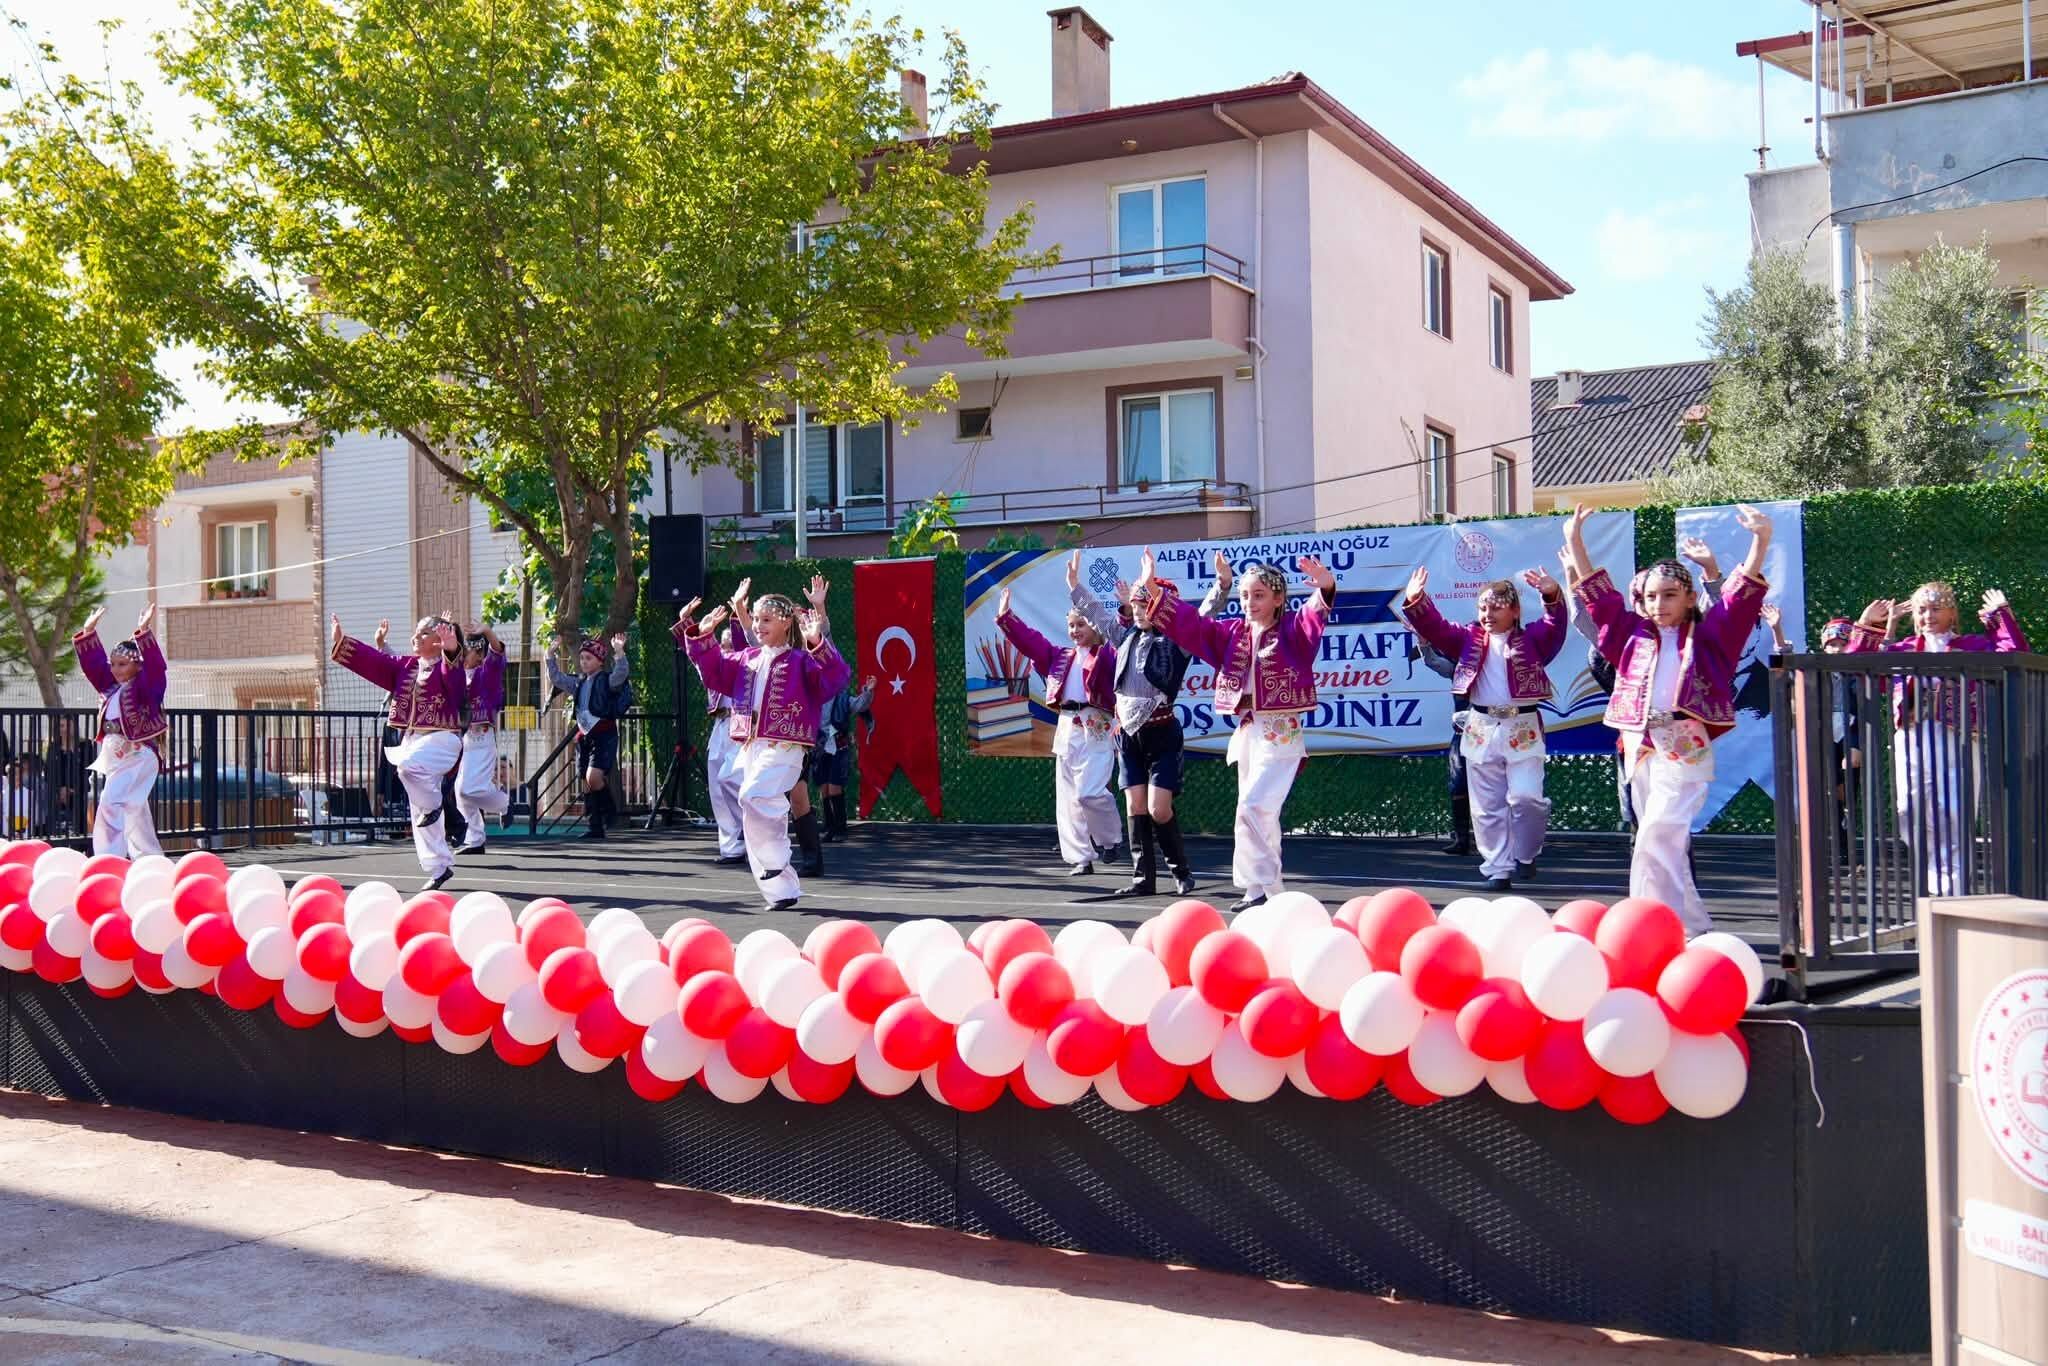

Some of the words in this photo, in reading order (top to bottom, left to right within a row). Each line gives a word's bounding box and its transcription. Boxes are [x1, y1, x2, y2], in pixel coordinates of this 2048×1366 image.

[1157, 548, 1208, 562] ALBAY
[1275, 539, 1334, 555] NURAN
[1338, 535, 1391, 551] OĞUZ
[1320, 631, 1414, 661] HAFT
[1173, 703, 1214, 735] OŞ
